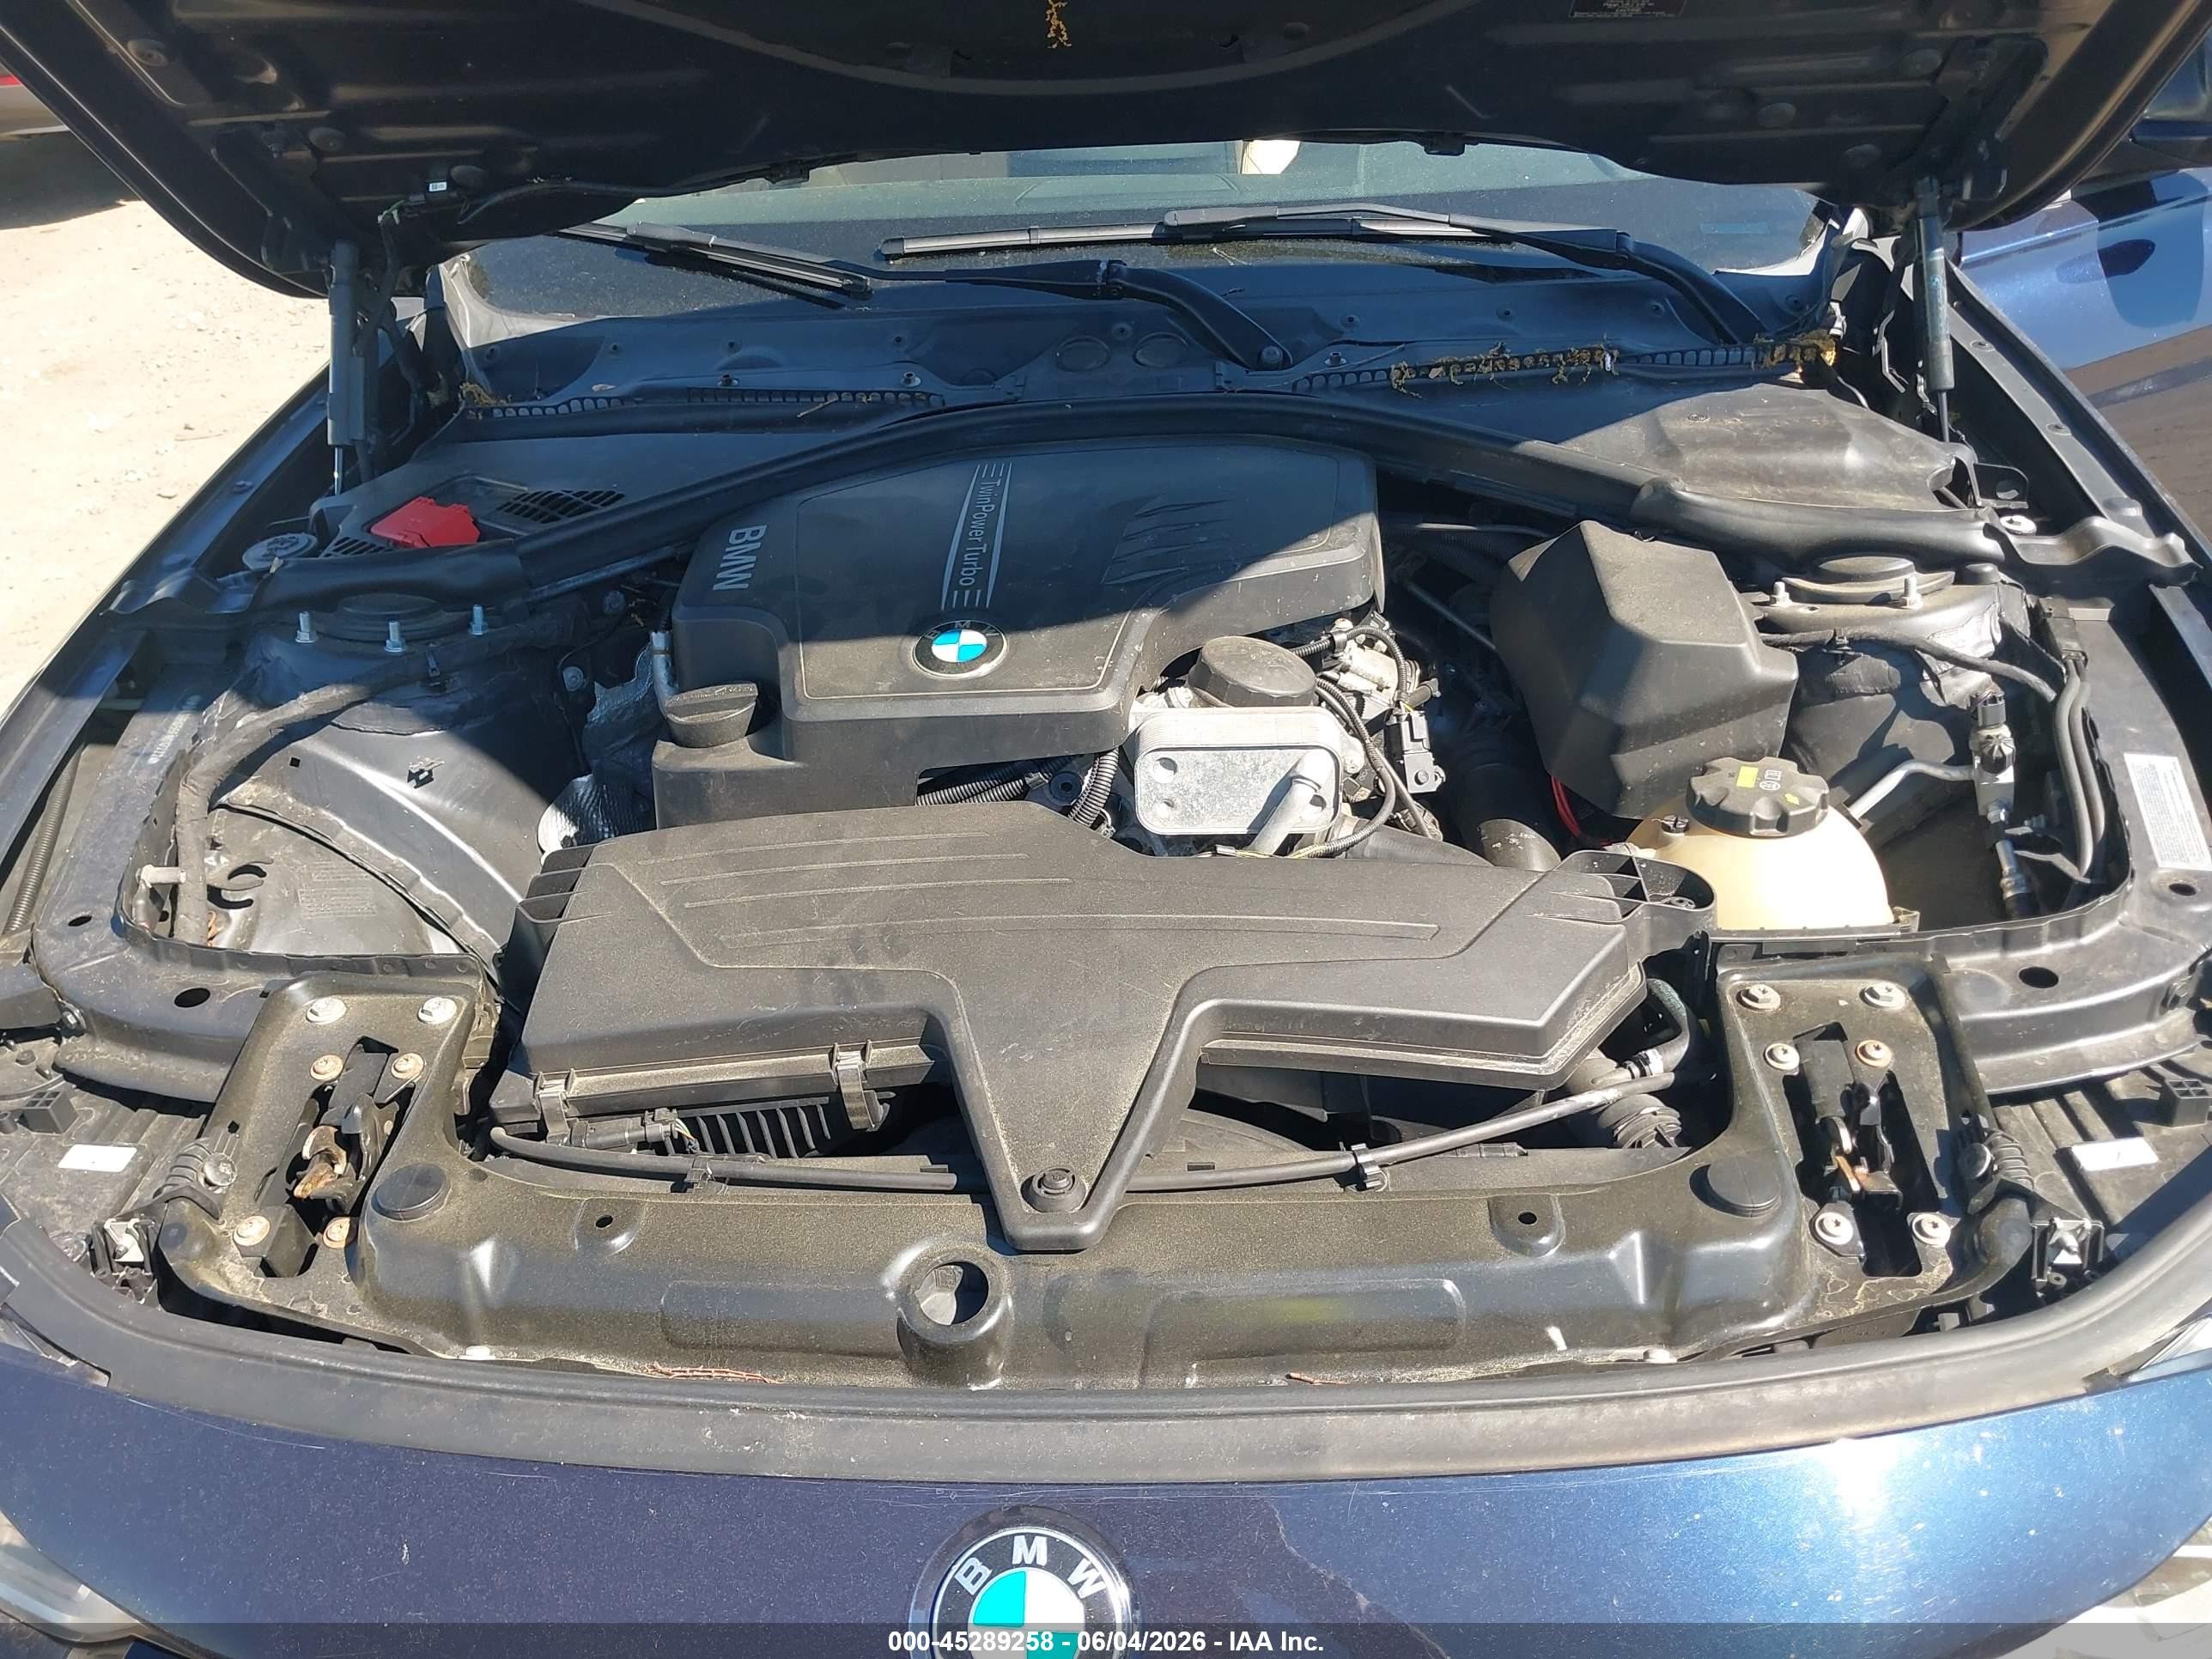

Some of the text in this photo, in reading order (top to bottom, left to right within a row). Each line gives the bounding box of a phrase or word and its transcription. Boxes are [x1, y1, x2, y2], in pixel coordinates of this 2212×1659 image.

[713, 525, 768, 591] BMW
[958, 478, 1002, 586] TwinPower Turbo
[924, 619, 1000, 640] BMW
[954, 1534, 1107, 1599] BMW
